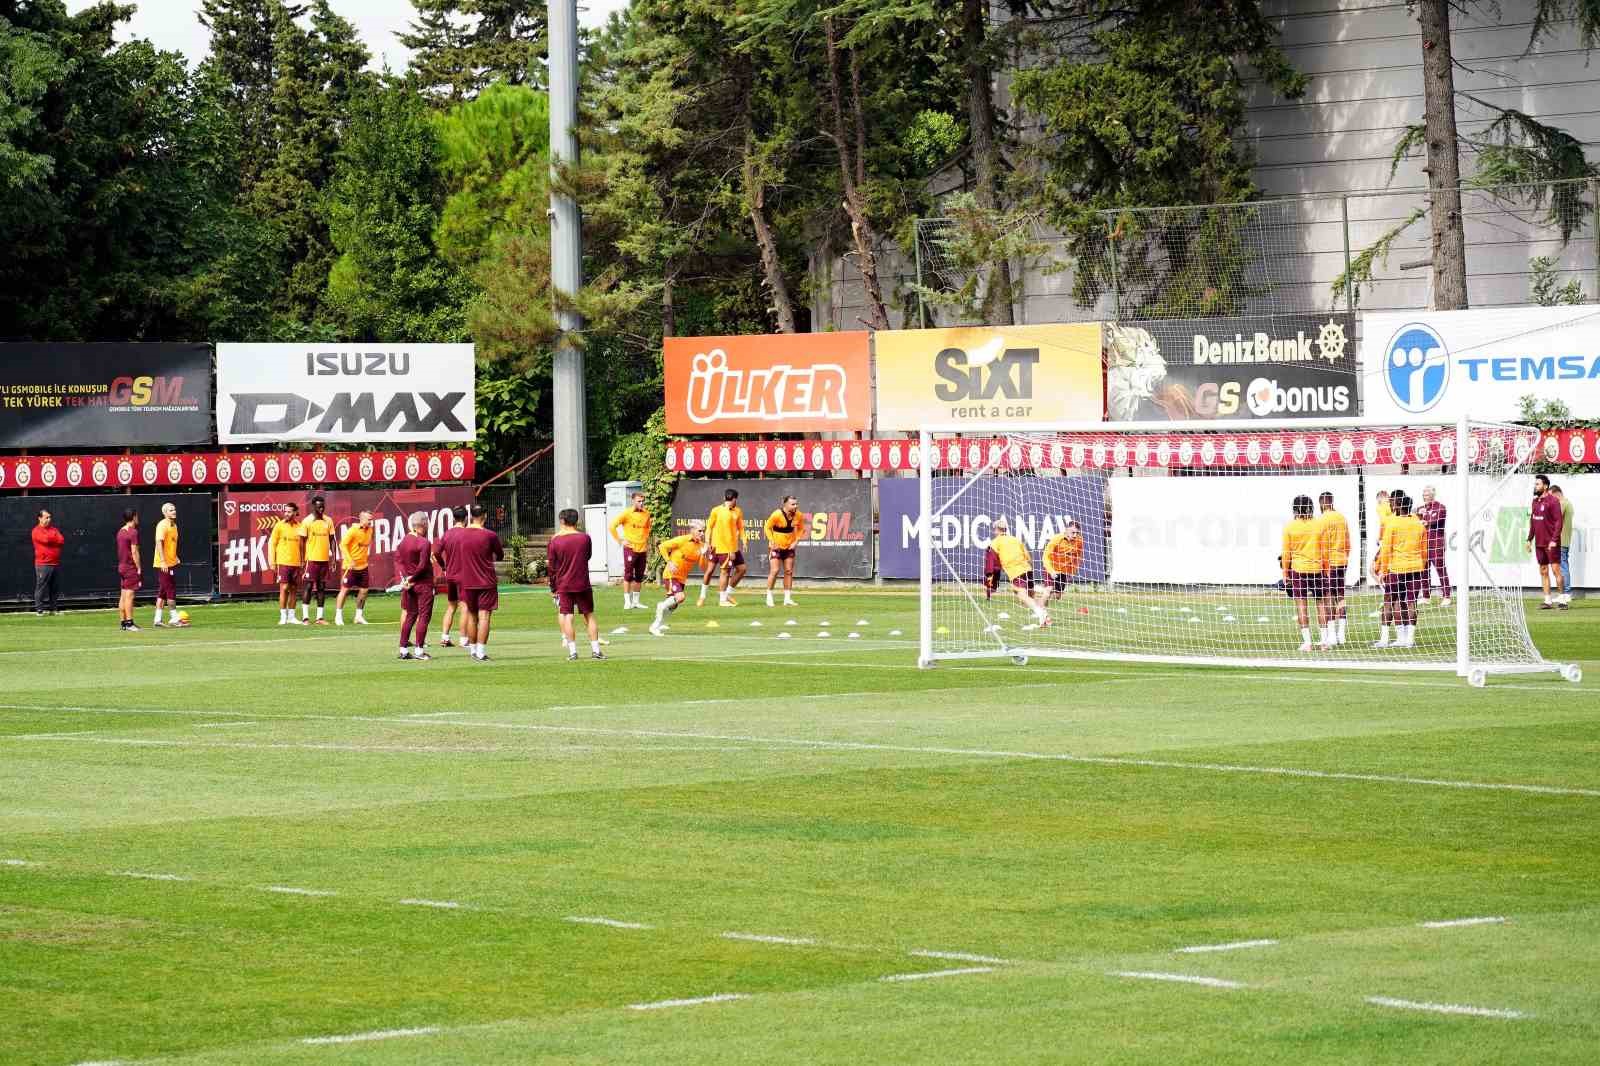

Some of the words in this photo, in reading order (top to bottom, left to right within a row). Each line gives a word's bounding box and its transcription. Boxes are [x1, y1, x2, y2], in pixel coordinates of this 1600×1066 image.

[1193, 331, 1313, 364] DenizBank
[307, 352, 410, 376] ISUZU
[11, 384, 53, 395] GSMOBILE
[68, 384, 108, 395] KONUŞUR
[110, 376, 184, 406] GSM
[687, 348, 848, 425] ÜLKER
[1195, 382, 1241, 417] GS
[1271, 380, 1349, 413] bonus
[3, 396, 23, 408] TEK
[27, 394, 63, 408] YÜREK
[65, 396, 85, 407] TEK
[951, 404, 987, 419] rent
[991, 406, 1001, 418] a
[1005, 406, 1033, 418] car
